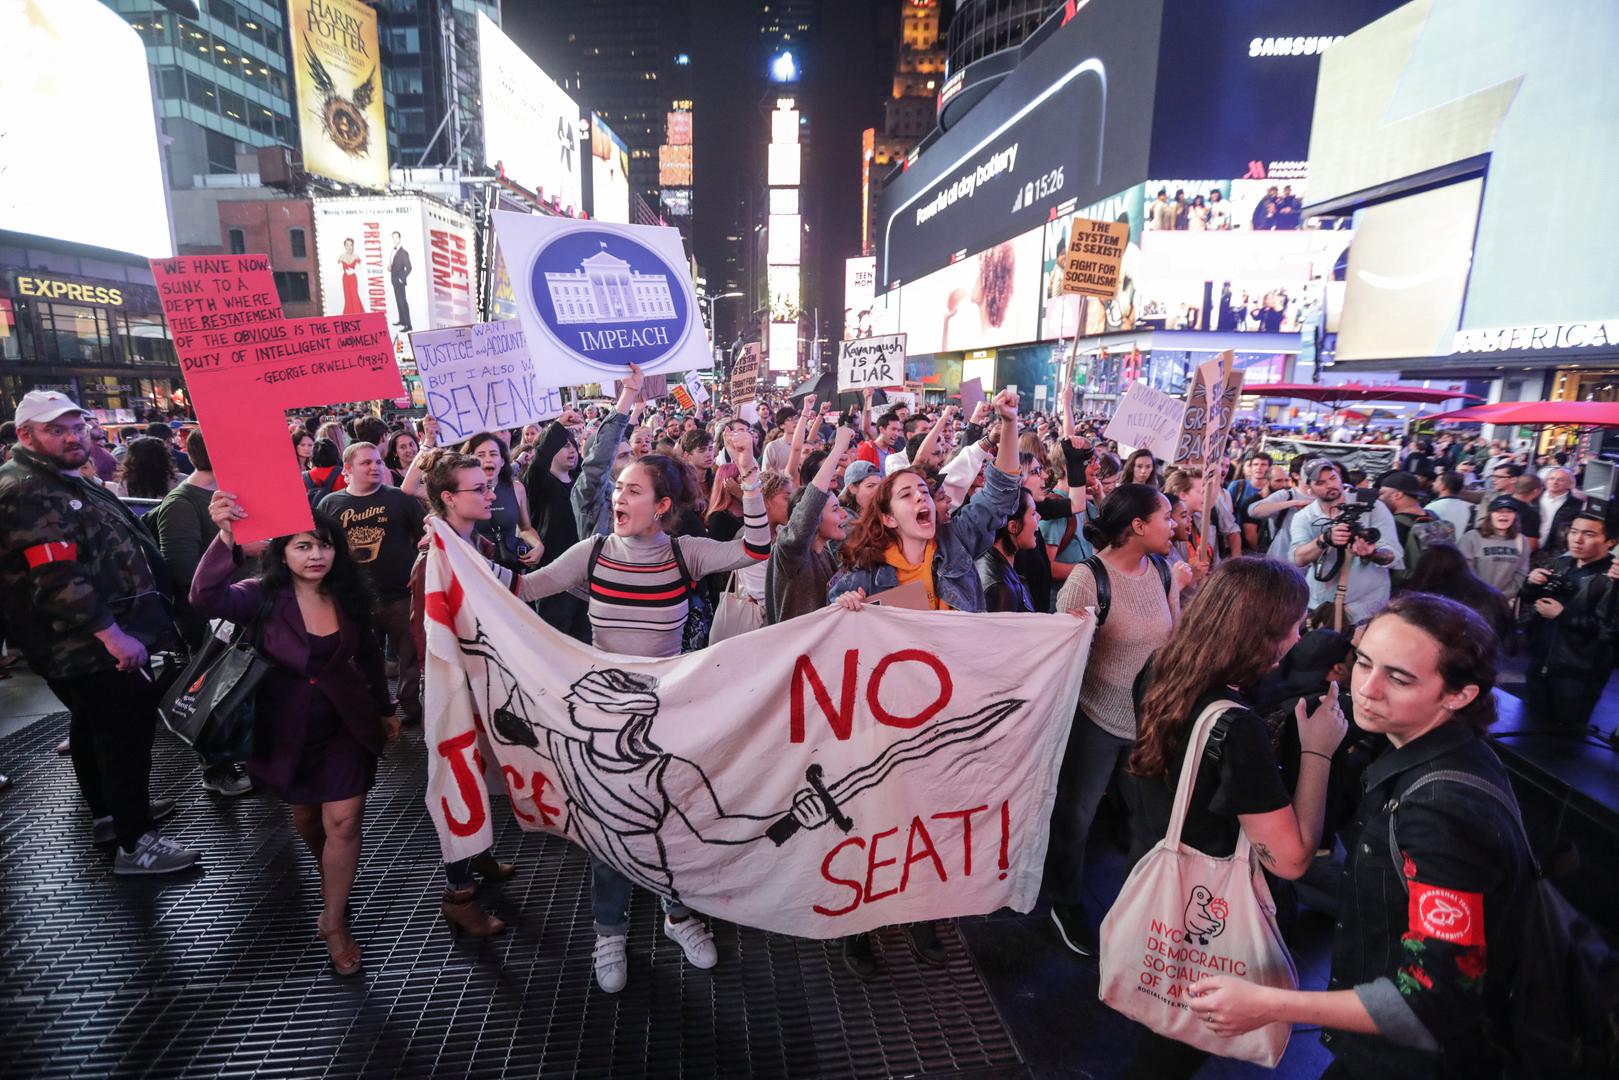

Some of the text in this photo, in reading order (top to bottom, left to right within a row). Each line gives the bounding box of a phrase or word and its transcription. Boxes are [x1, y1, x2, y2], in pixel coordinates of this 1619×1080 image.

[310, 0, 364, 34] HARRY
[306, 8, 370, 59] POTTER
[957, 172, 977, 198] day
[976, 143, 1018, 187] battery
[1035, 166, 1064, 200] 15:26
[1077, 231, 1120, 246] SYSTEM
[1091, 222, 1111, 233] THE
[363, 222, 383, 268] PRETTY
[1071, 242, 1122, 258] IS SEXIST!
[193, 259, 232, 274] HAVE
[238, 258, 268, 273] NOW
[1070, 259, 1116, 275] FIGHT FOR
[18, 276, 123, 306] EXPRESS
[162, 277, 249, 295] SUNK TO A
[1065, 271, 1118, 287] SOCIALISM!
[165, 293, 272, 313] DEPTH WHERE
[170, 306, 281, 331] THE RESTATEMENT
[455, 321, 506, 338] I WANT
[176, 319, 361, 348] OF THE OBVIOUS IS THE FIRST
[578, 326, 669, 351] IMPEACH
[183, 352, 220, 371] DUTY
[231, 350, 247, 363] OF
[255, 338, 331, 361] INTELLIGENT
[415, 339, 474, 372] JUSTICE
[486, 331, 527, 357] ACCOUNT
[843, 337, 903, 359] Kavanaugh
[874, 353, 887, 365] A
[429, 371, 457, 389] BUT
[466, 369, 476, 379] I
[481, 364, 515, 378] ALSO
[850, 364, 894, 383] LIAR
[427, 373, 562, 441] REVENGE
[1184, 406, 1231, 430] GRAS
[340, 505, 386, 528] Poutine
[789, 648, 953, 744] NO
[812, 799, 1011, 917] SEAT!
[1150, 919, 1184, 944] NYC
[1143, 954, 1215, 982] SOCIALI
[1147, 936, 1247, 977] DEMOCRATIC
[1140, 971, 1163, 987] OF
